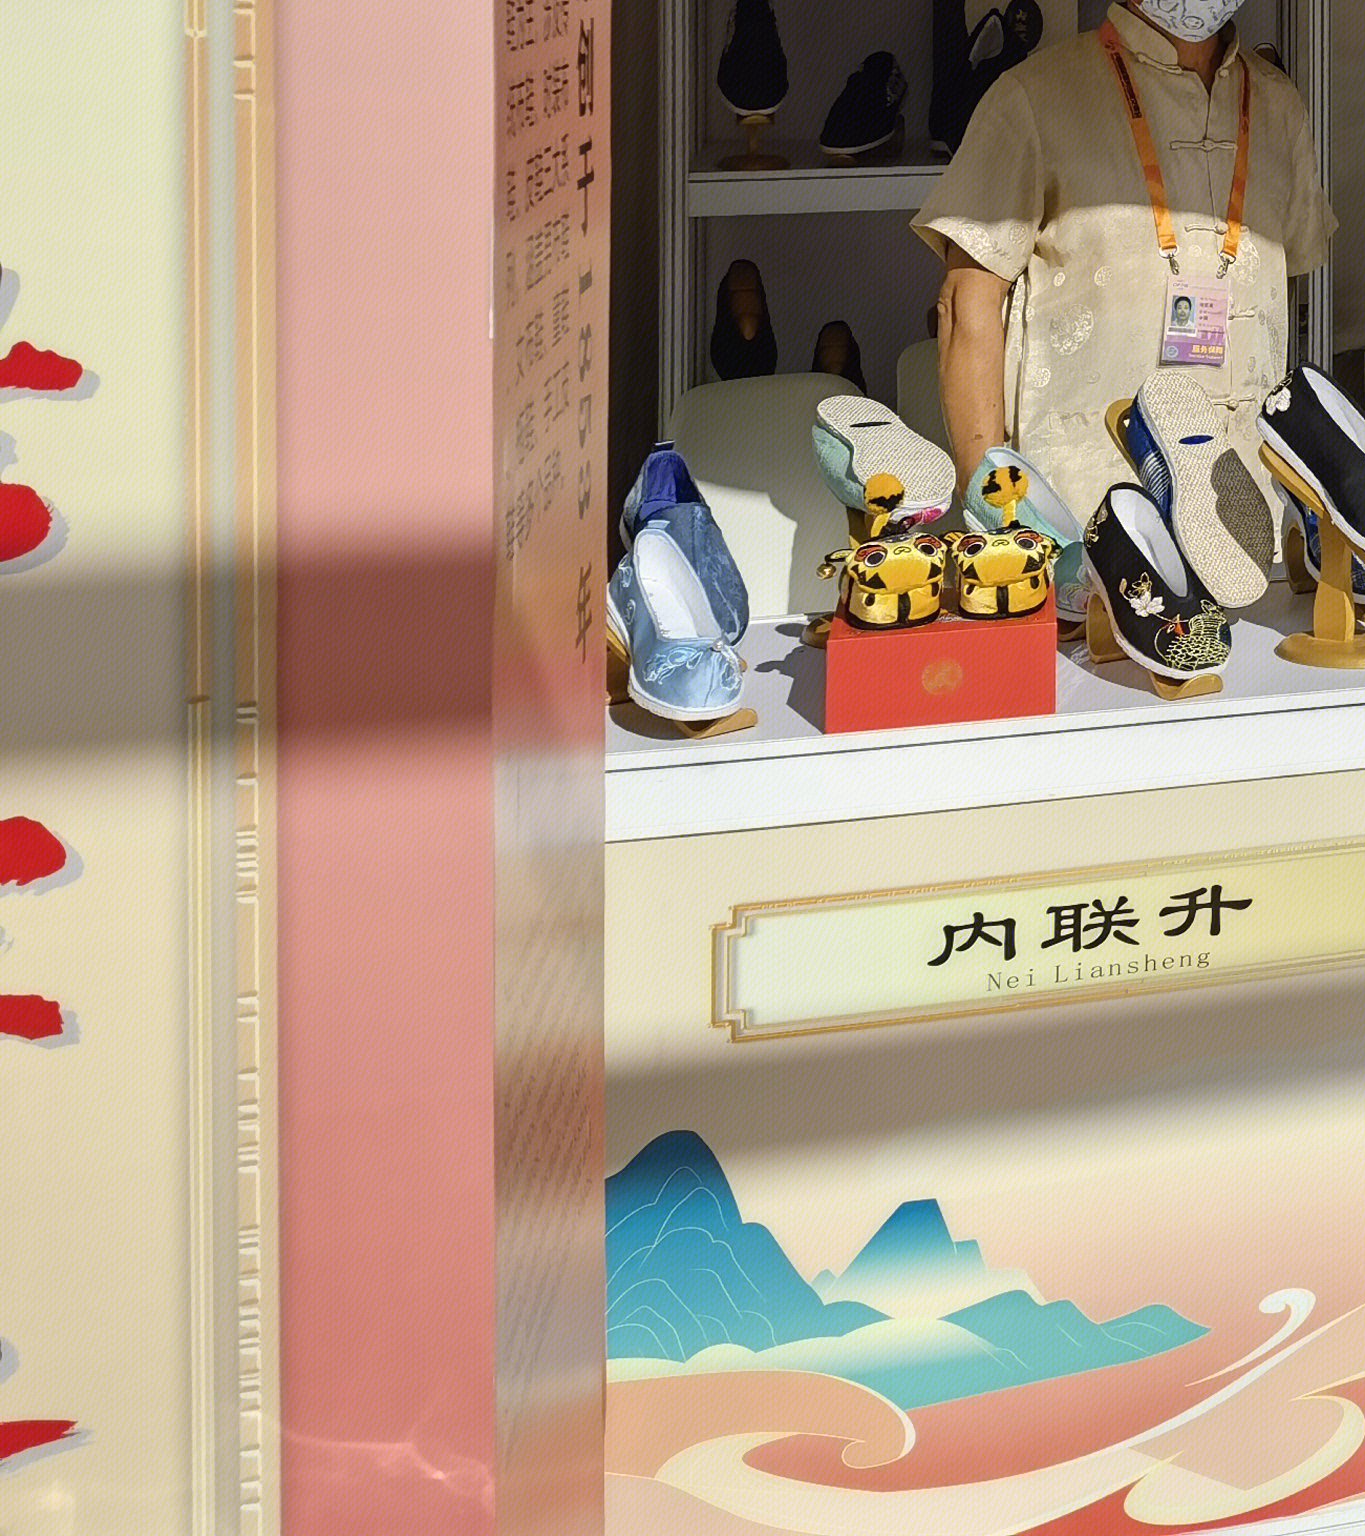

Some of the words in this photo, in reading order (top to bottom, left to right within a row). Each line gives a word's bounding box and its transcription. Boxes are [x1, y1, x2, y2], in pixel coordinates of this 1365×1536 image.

[926, 883, 1254, 967] 内联升
[985, 966, 1037, 993] Nei
[1052, 949, 1211, 984] Liansheng
